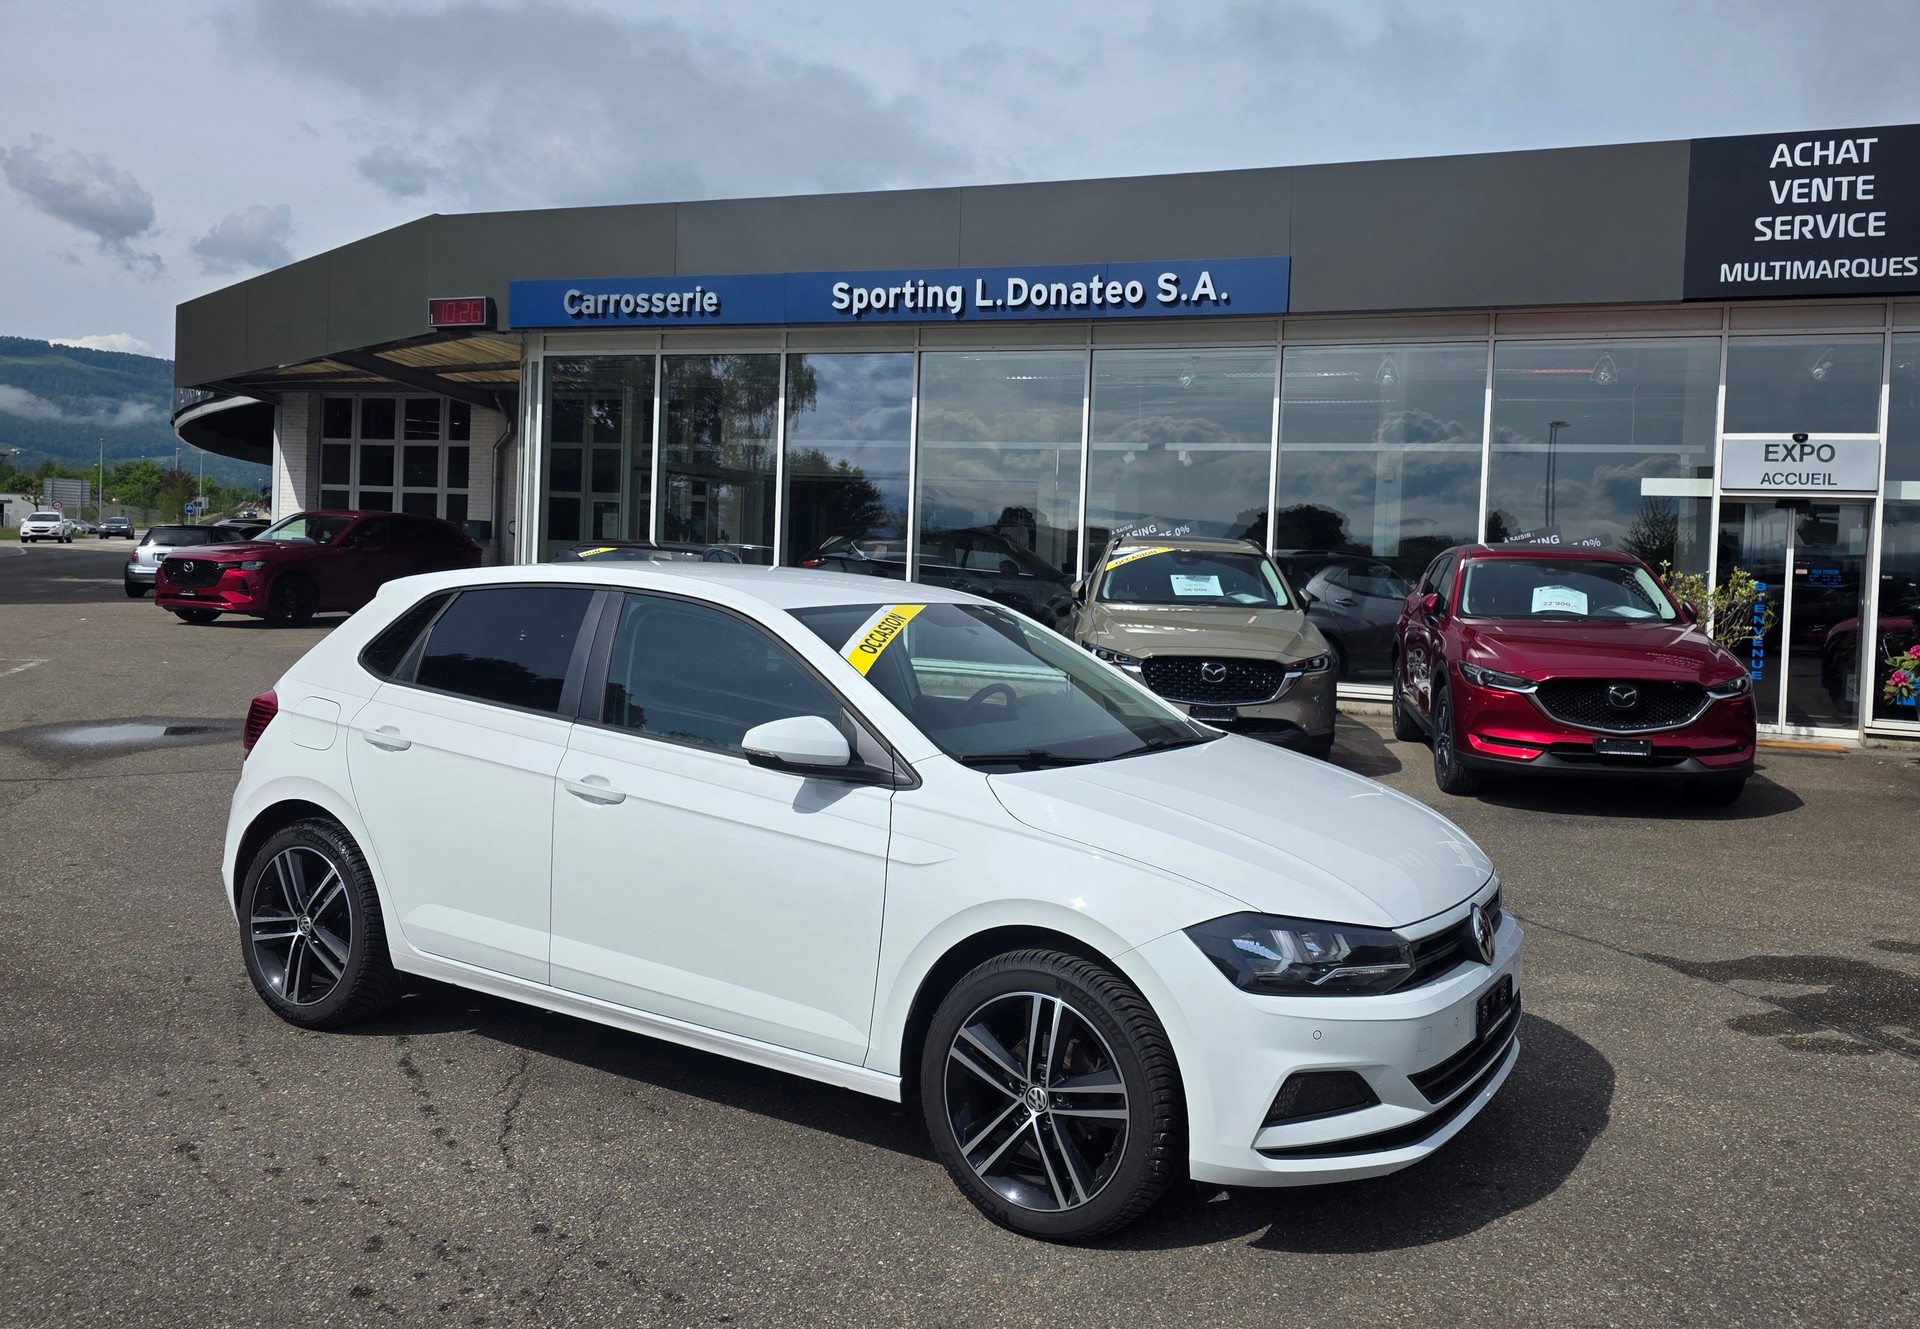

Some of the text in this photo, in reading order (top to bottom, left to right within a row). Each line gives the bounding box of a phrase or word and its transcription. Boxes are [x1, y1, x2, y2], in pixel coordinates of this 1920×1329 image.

[1769, 137, 1879, 169] ACHAT
[1769, 174, 1875, 205] VENTE
[1754, 211, 1887, 242] SERVICE
[1719, 256, 1919, 283] MULTIMARQUES
[563, 285, 718, 315] Carrosserie
[831, 271, 1229, 315] Sporting L.Donateo S.A.
[1763, 443, 1836, 463] EXPO
[1760, 472, 1838, 486] ACCUEIL
[858, 612, 908, 655] OCCASION
[1071, 989, 1126, 1046] MICHELIN
